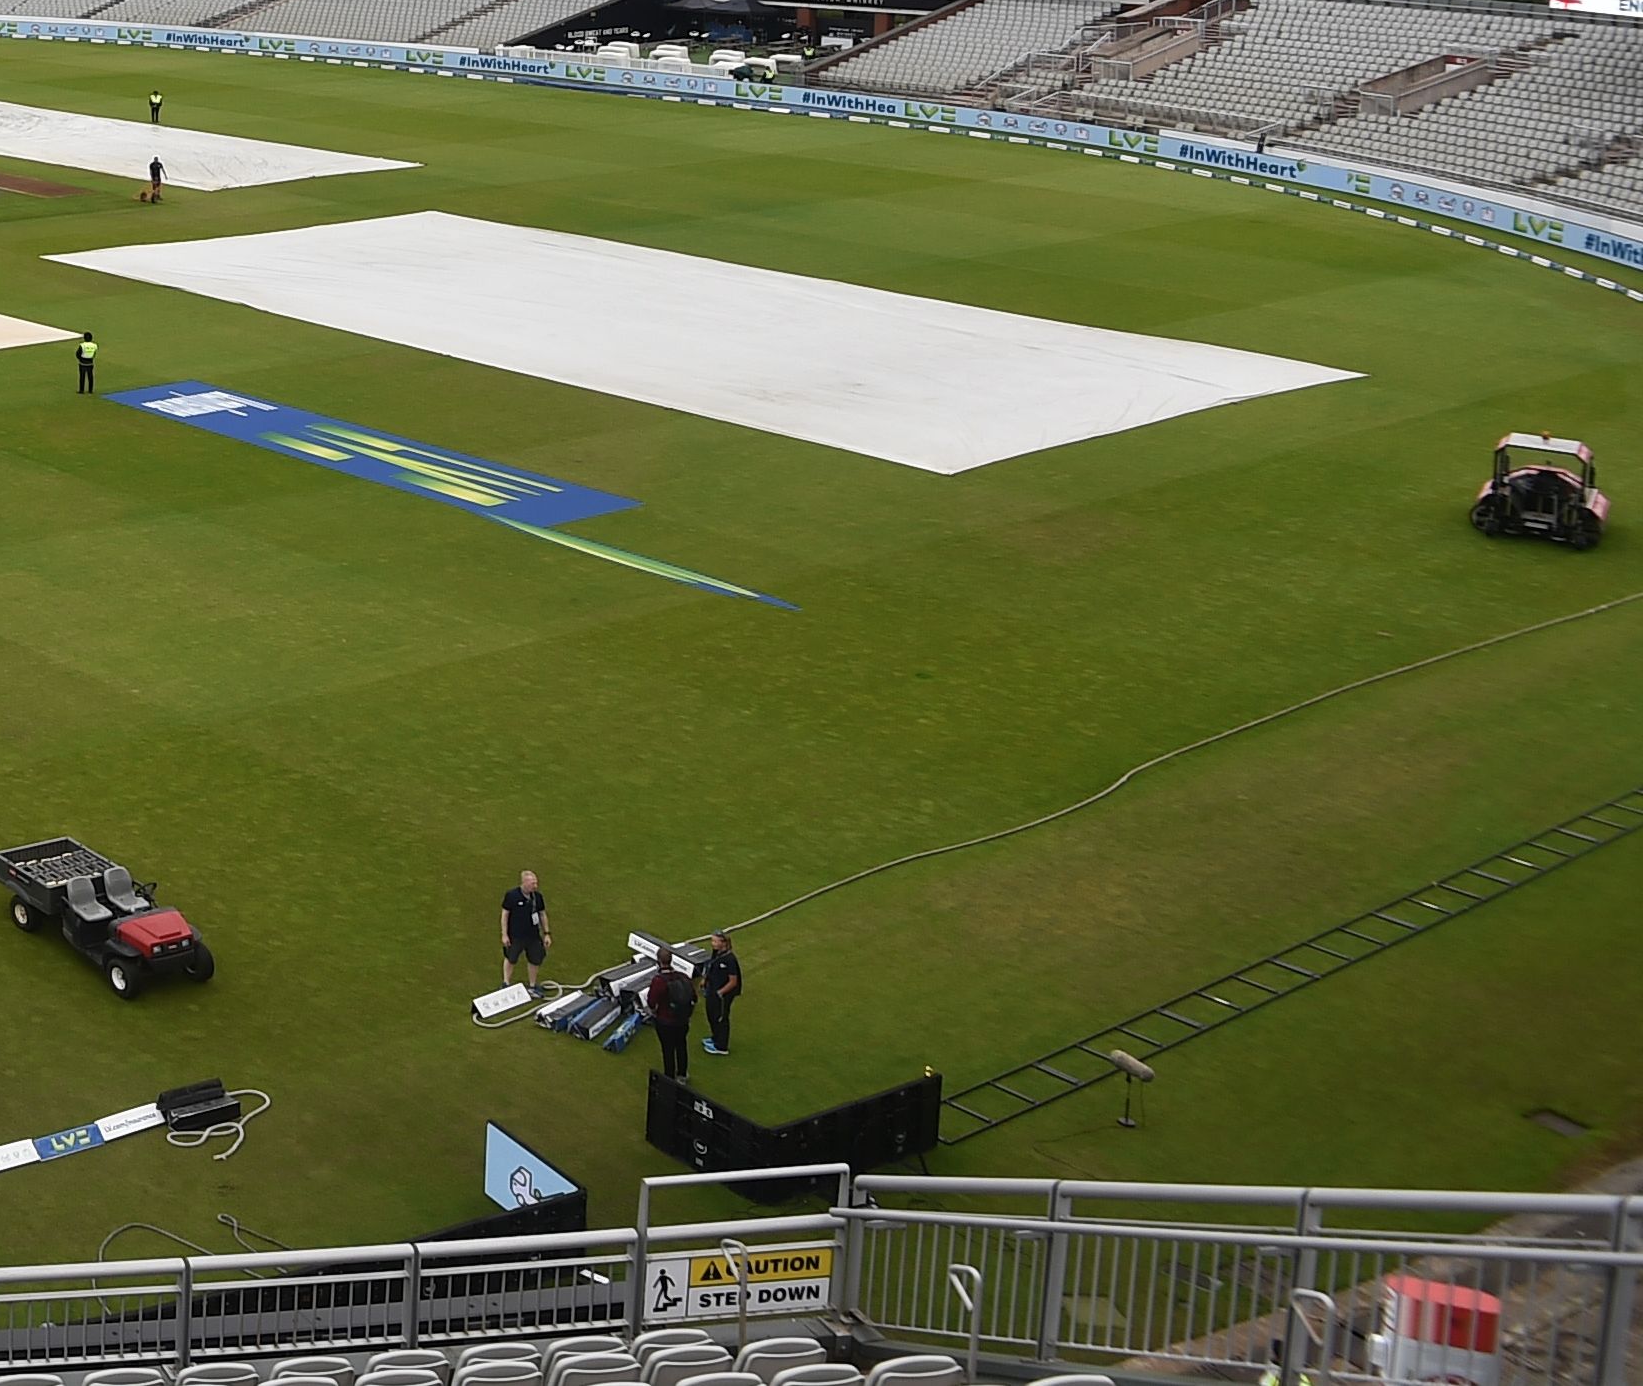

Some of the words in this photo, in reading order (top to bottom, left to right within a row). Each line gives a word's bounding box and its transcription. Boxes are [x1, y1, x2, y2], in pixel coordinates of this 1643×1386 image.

[165, 32, 245, 47] #InWithHeart
[459, 56, 549, 74] #InWithHeart
[802, 92, 896, 114] #InWithHea
[1179, 144, 1297, 179] #InWithHeart
[758, 1285, 820, 1303] DOWN
